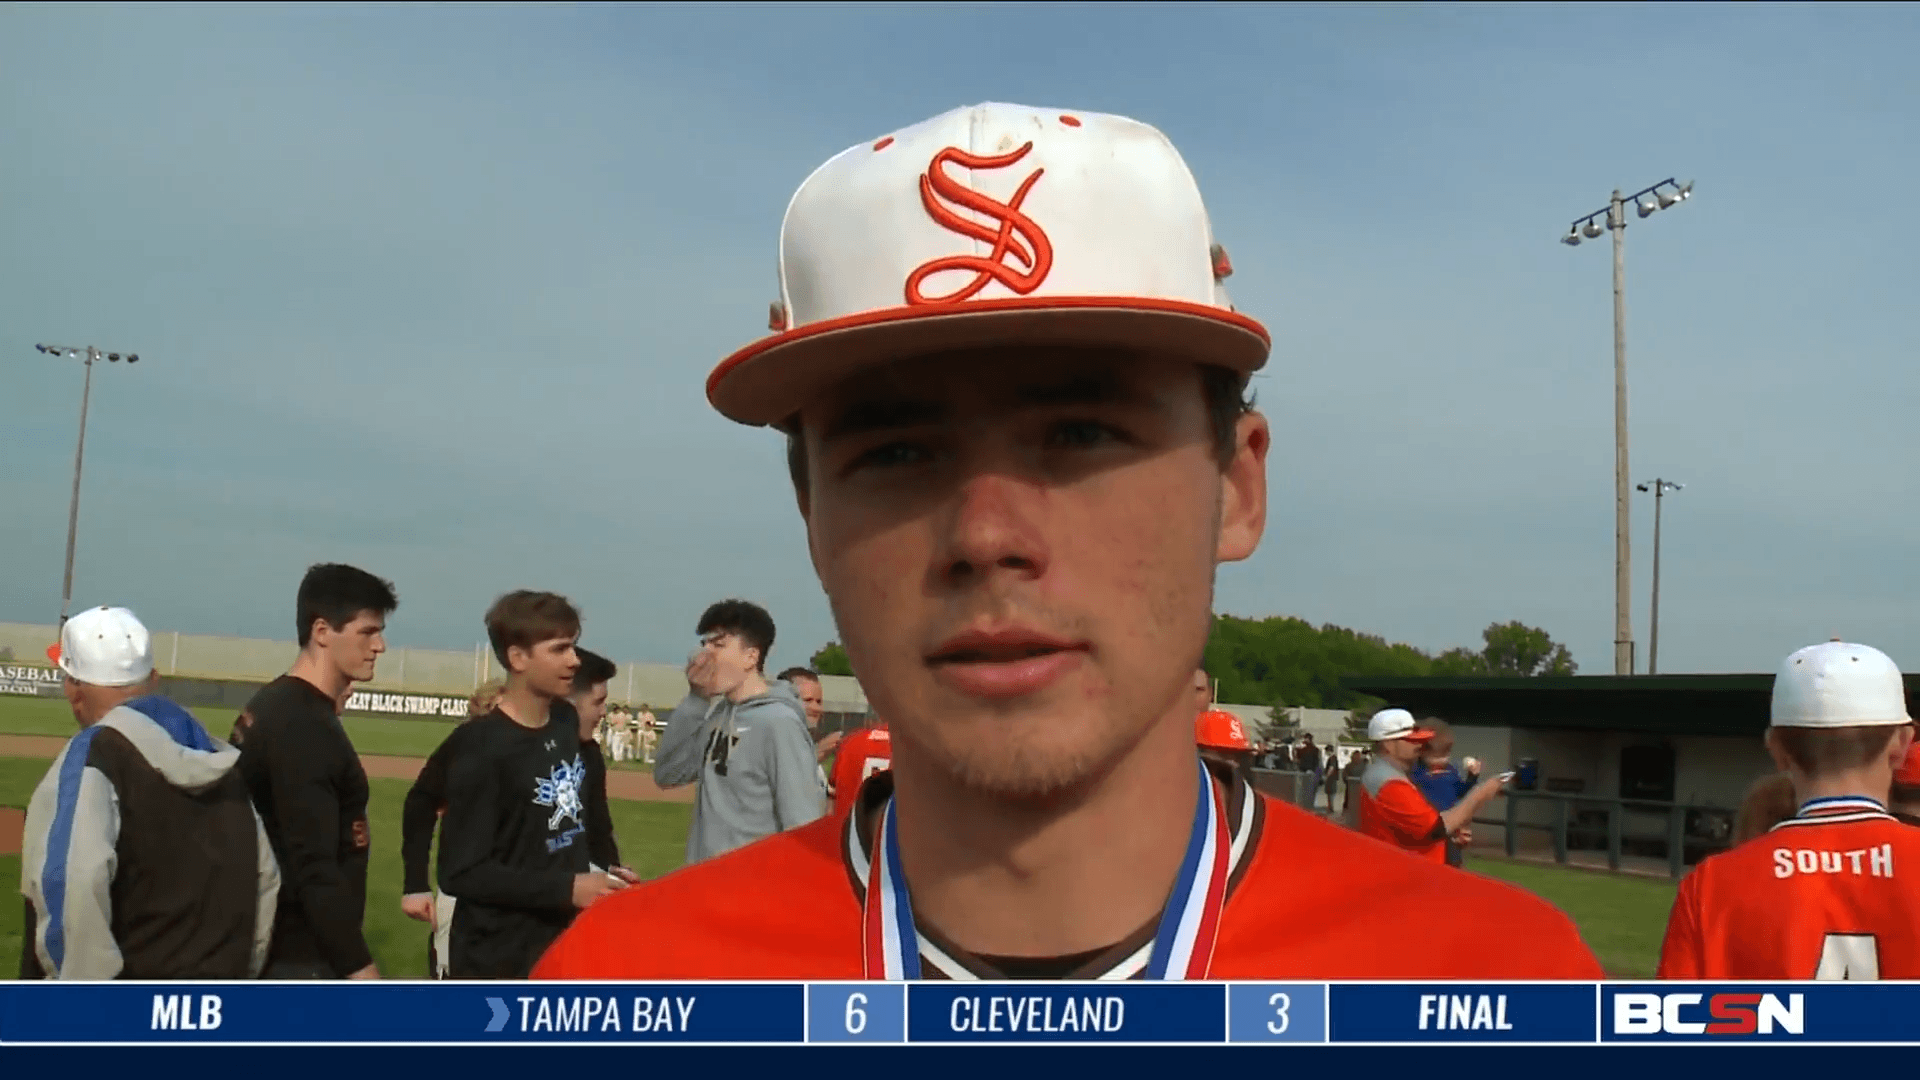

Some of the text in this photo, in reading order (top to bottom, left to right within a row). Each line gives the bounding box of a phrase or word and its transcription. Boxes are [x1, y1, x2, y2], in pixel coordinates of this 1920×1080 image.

[371, 694, 404, 713] BLACK
[404, 696, 440, 715] SWAMP
[1773, 844, 1894, 879] SOUTH
